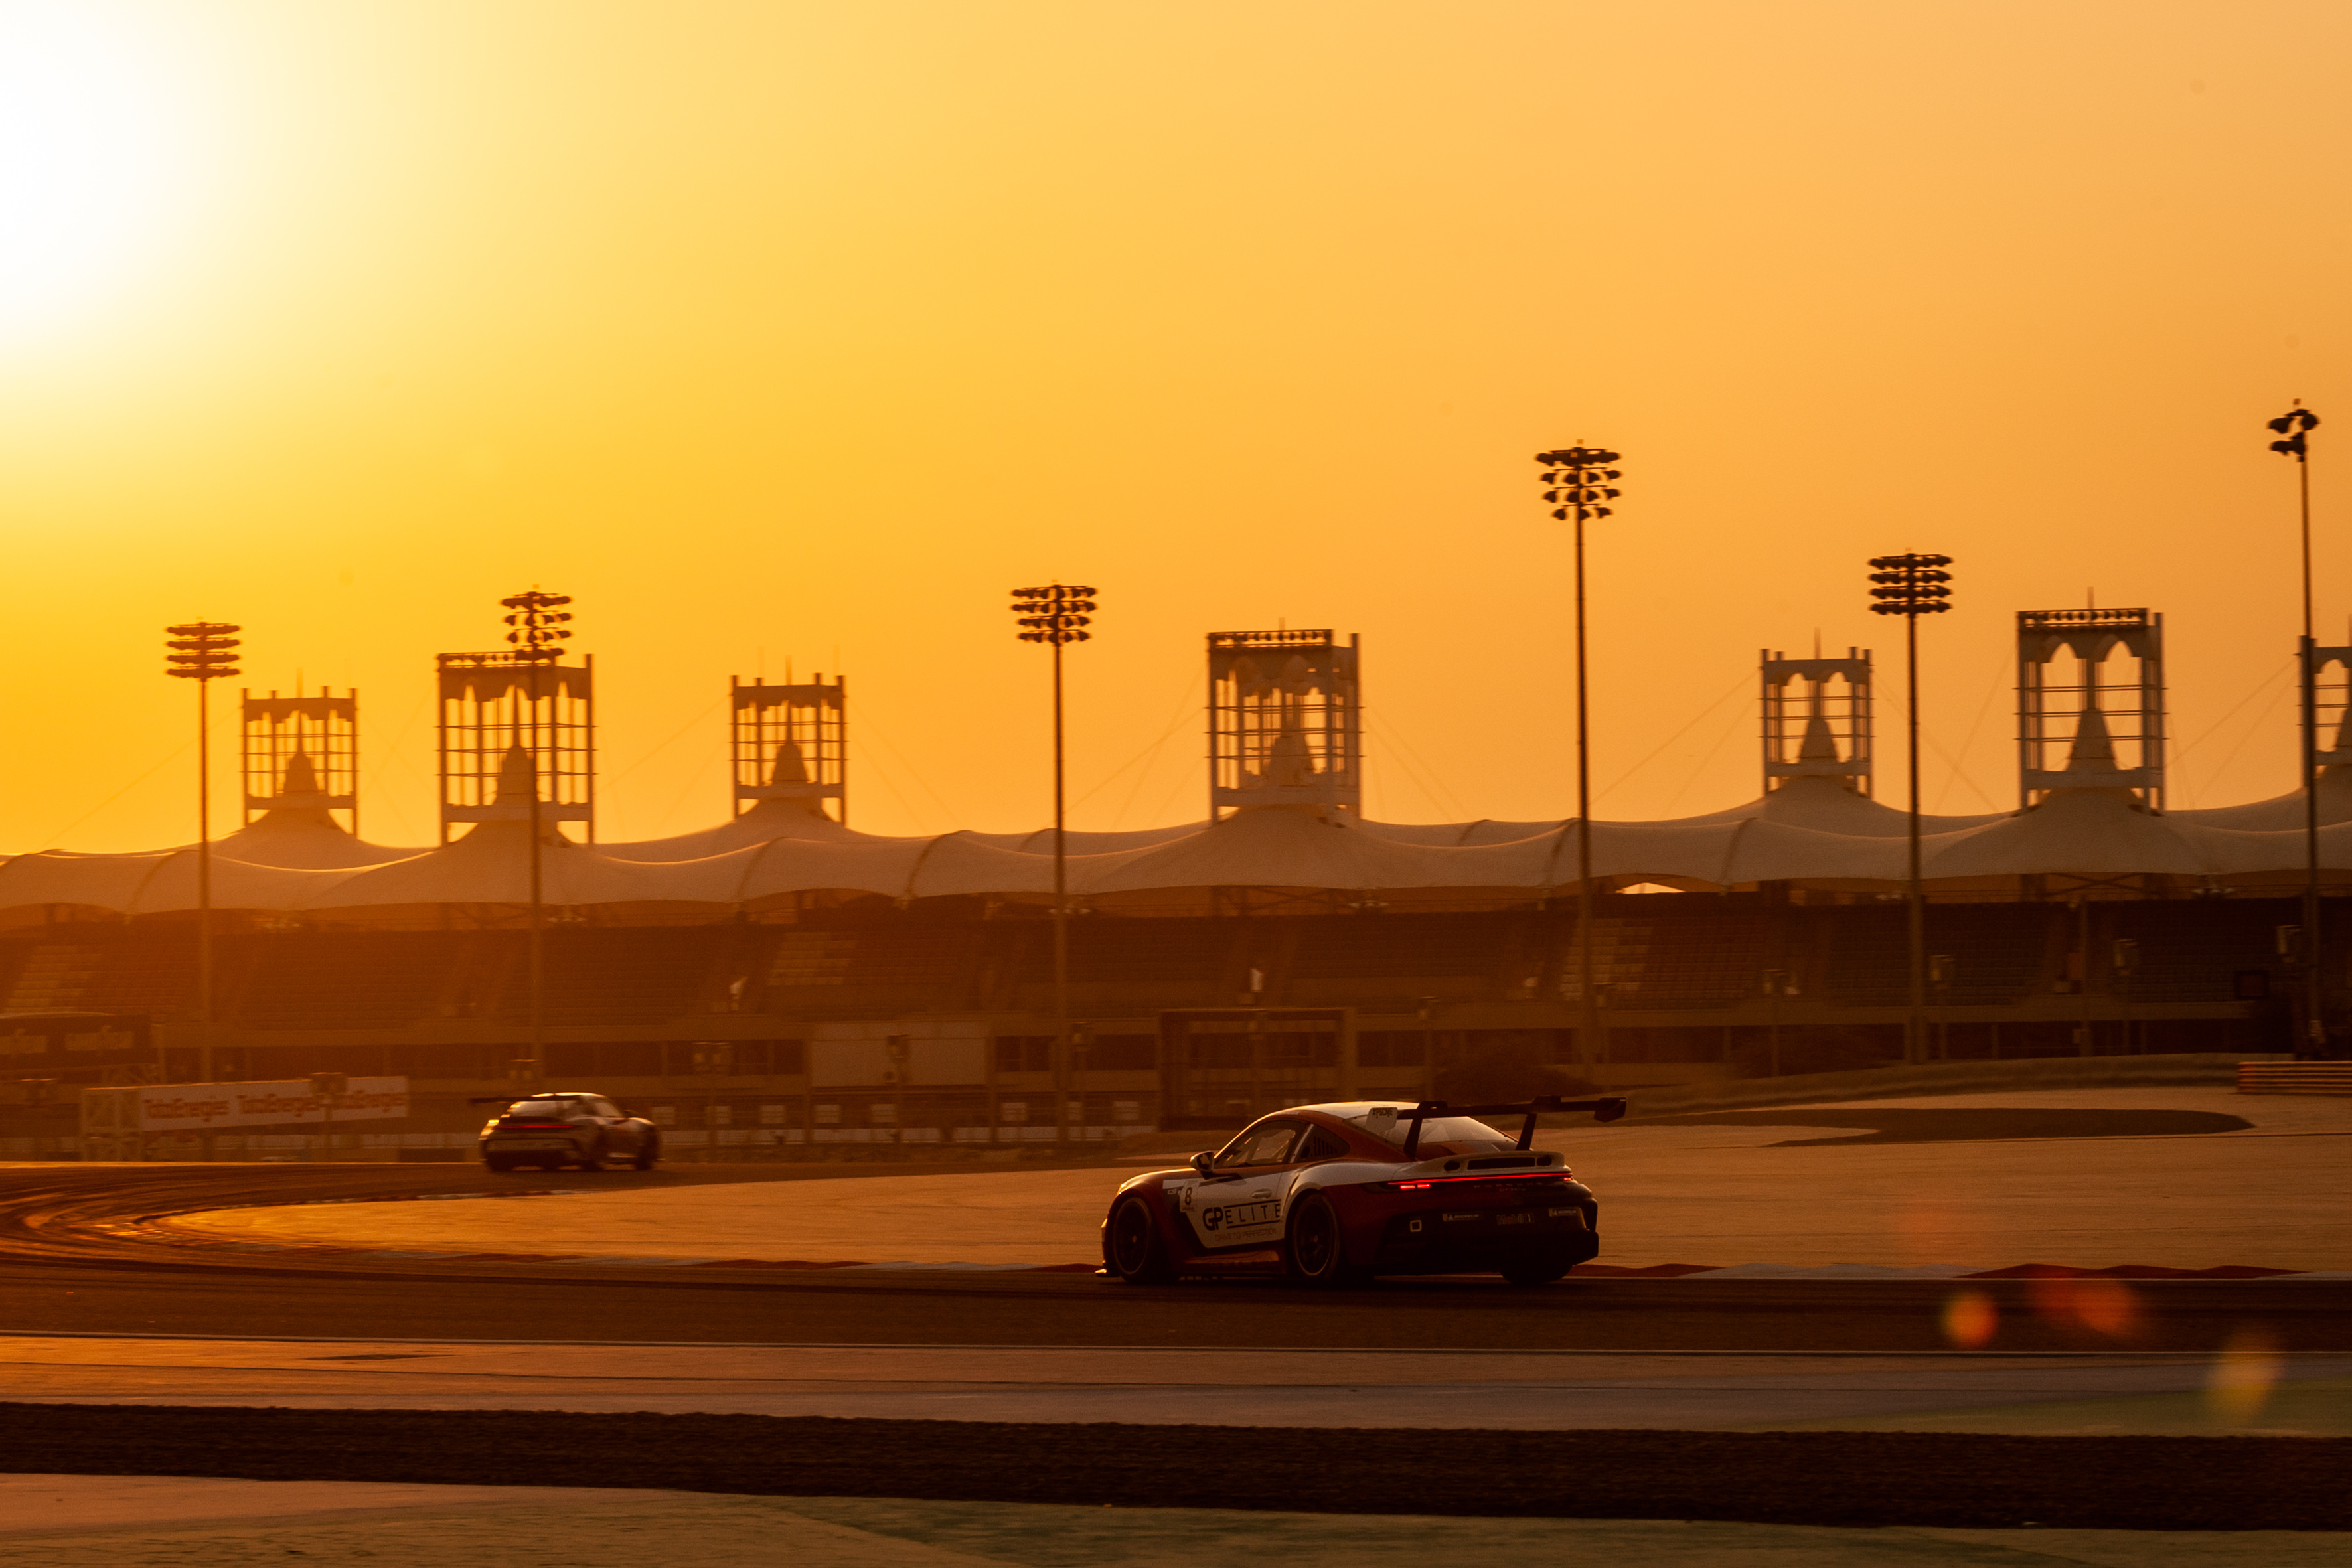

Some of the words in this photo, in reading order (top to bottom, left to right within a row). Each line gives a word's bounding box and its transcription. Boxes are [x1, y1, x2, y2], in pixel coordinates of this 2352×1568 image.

[1185, 1186, 1193, 1206] 8
[1202, 1206, 1223, 1231] GP
[1224, 1203, 1281, 1225] ELITE
[1496, 1213, 1524, 1225] Mobil
